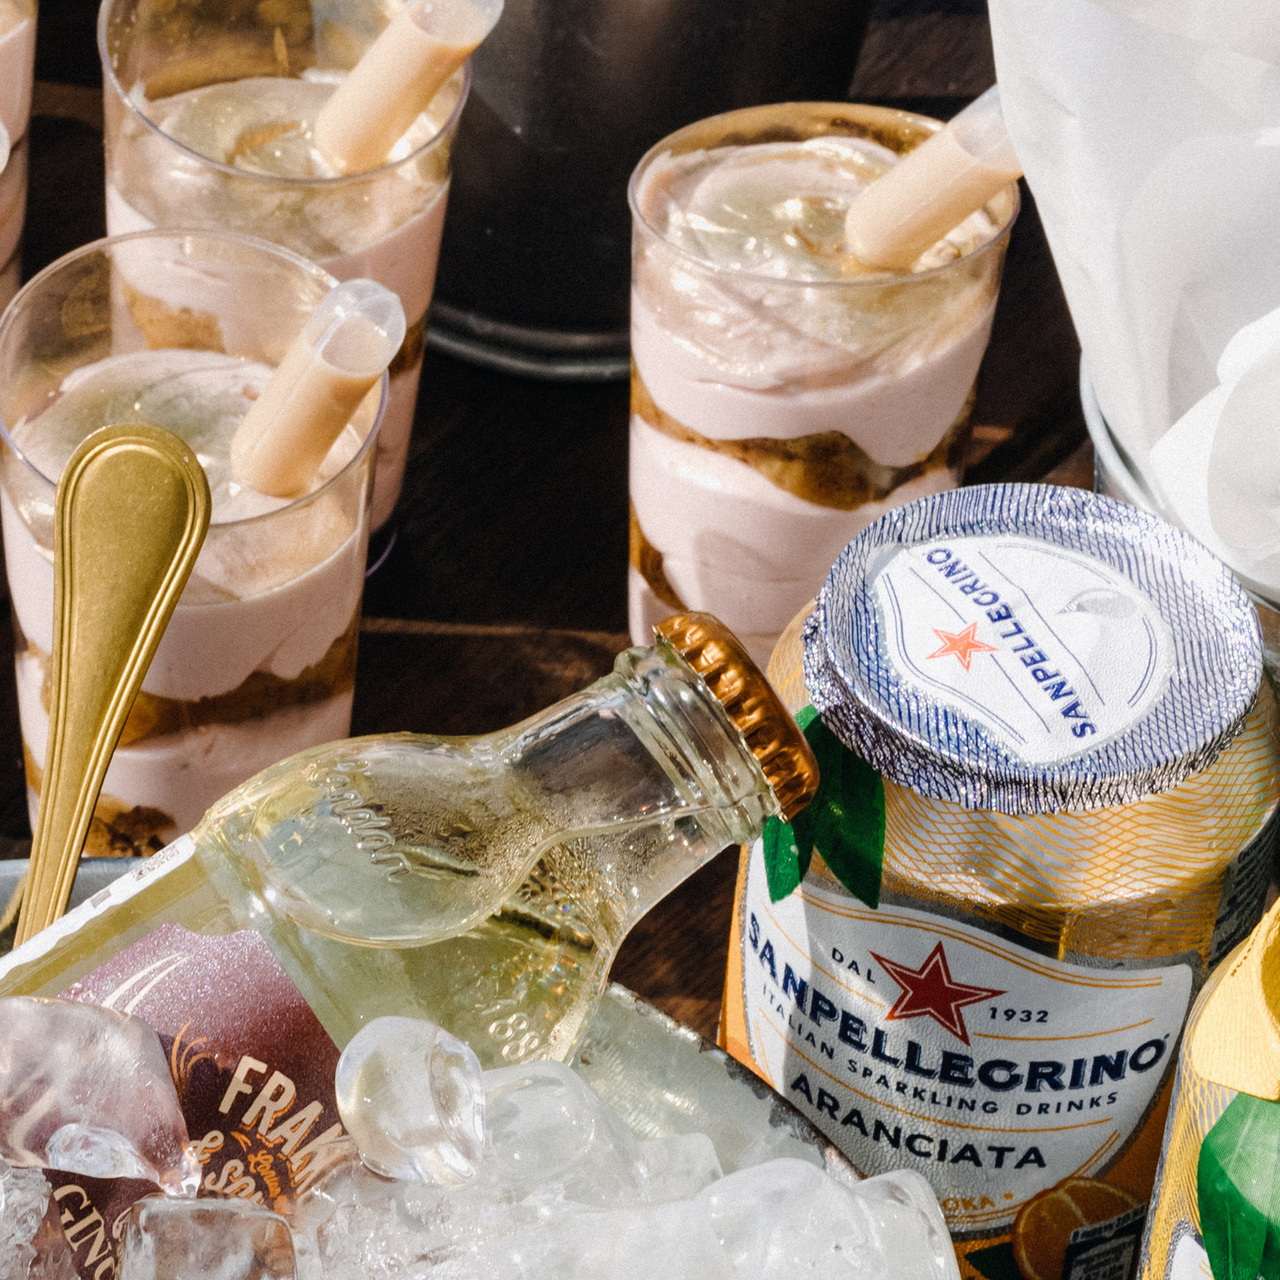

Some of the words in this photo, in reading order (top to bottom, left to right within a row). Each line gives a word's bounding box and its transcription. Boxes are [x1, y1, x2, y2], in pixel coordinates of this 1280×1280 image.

[926, 548, 1097, 738] SANPELLEGRINO
[748, 912, 1167, 1093] SANPELLEGRINO
[762, 983, 835, 1060] ITALIAN
[847, 1058, 999, 1115] SPARKLING
[1015, 1091, 1118, 1117] DRINKS
[831, 947, 876, 984] DAL
[989, 1006, 1050, 1024] 1932
[790, 1073, 1047, 1170] ARANCIATA
